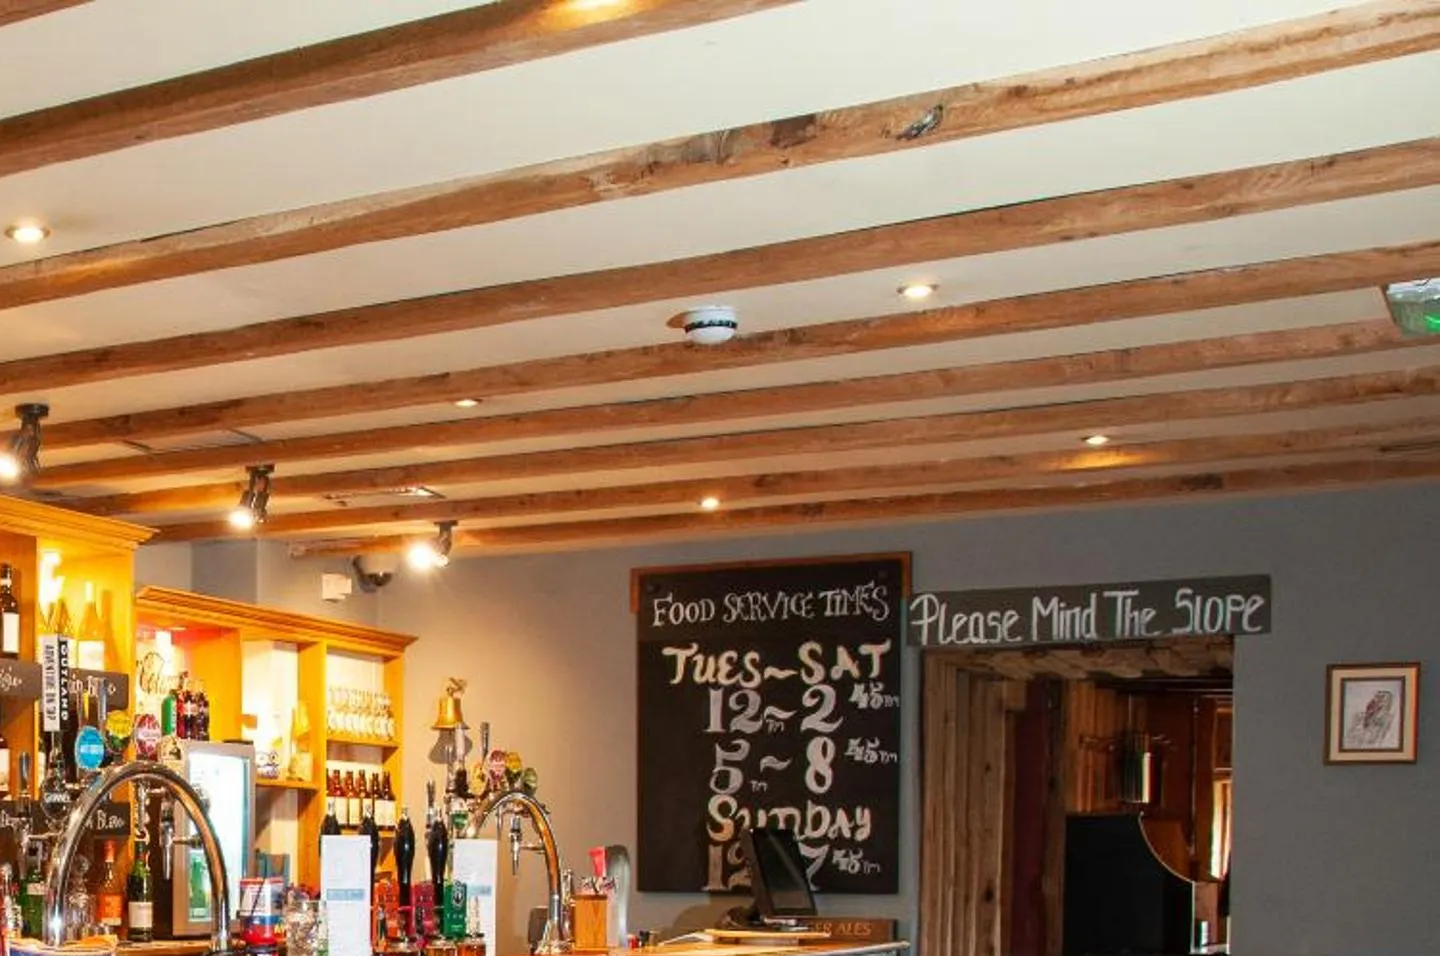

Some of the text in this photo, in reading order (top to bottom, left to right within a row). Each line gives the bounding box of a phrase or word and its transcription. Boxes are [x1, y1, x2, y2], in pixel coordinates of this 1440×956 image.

[652, 580, 891, 627] FOOD SERVICE TIMES
[910, 593, 1023, 646] Please
[1031, 592, 1098, 643] Mind
[1103, 589, 1162, 638] The
[836, 921, 873, 936] ALES
